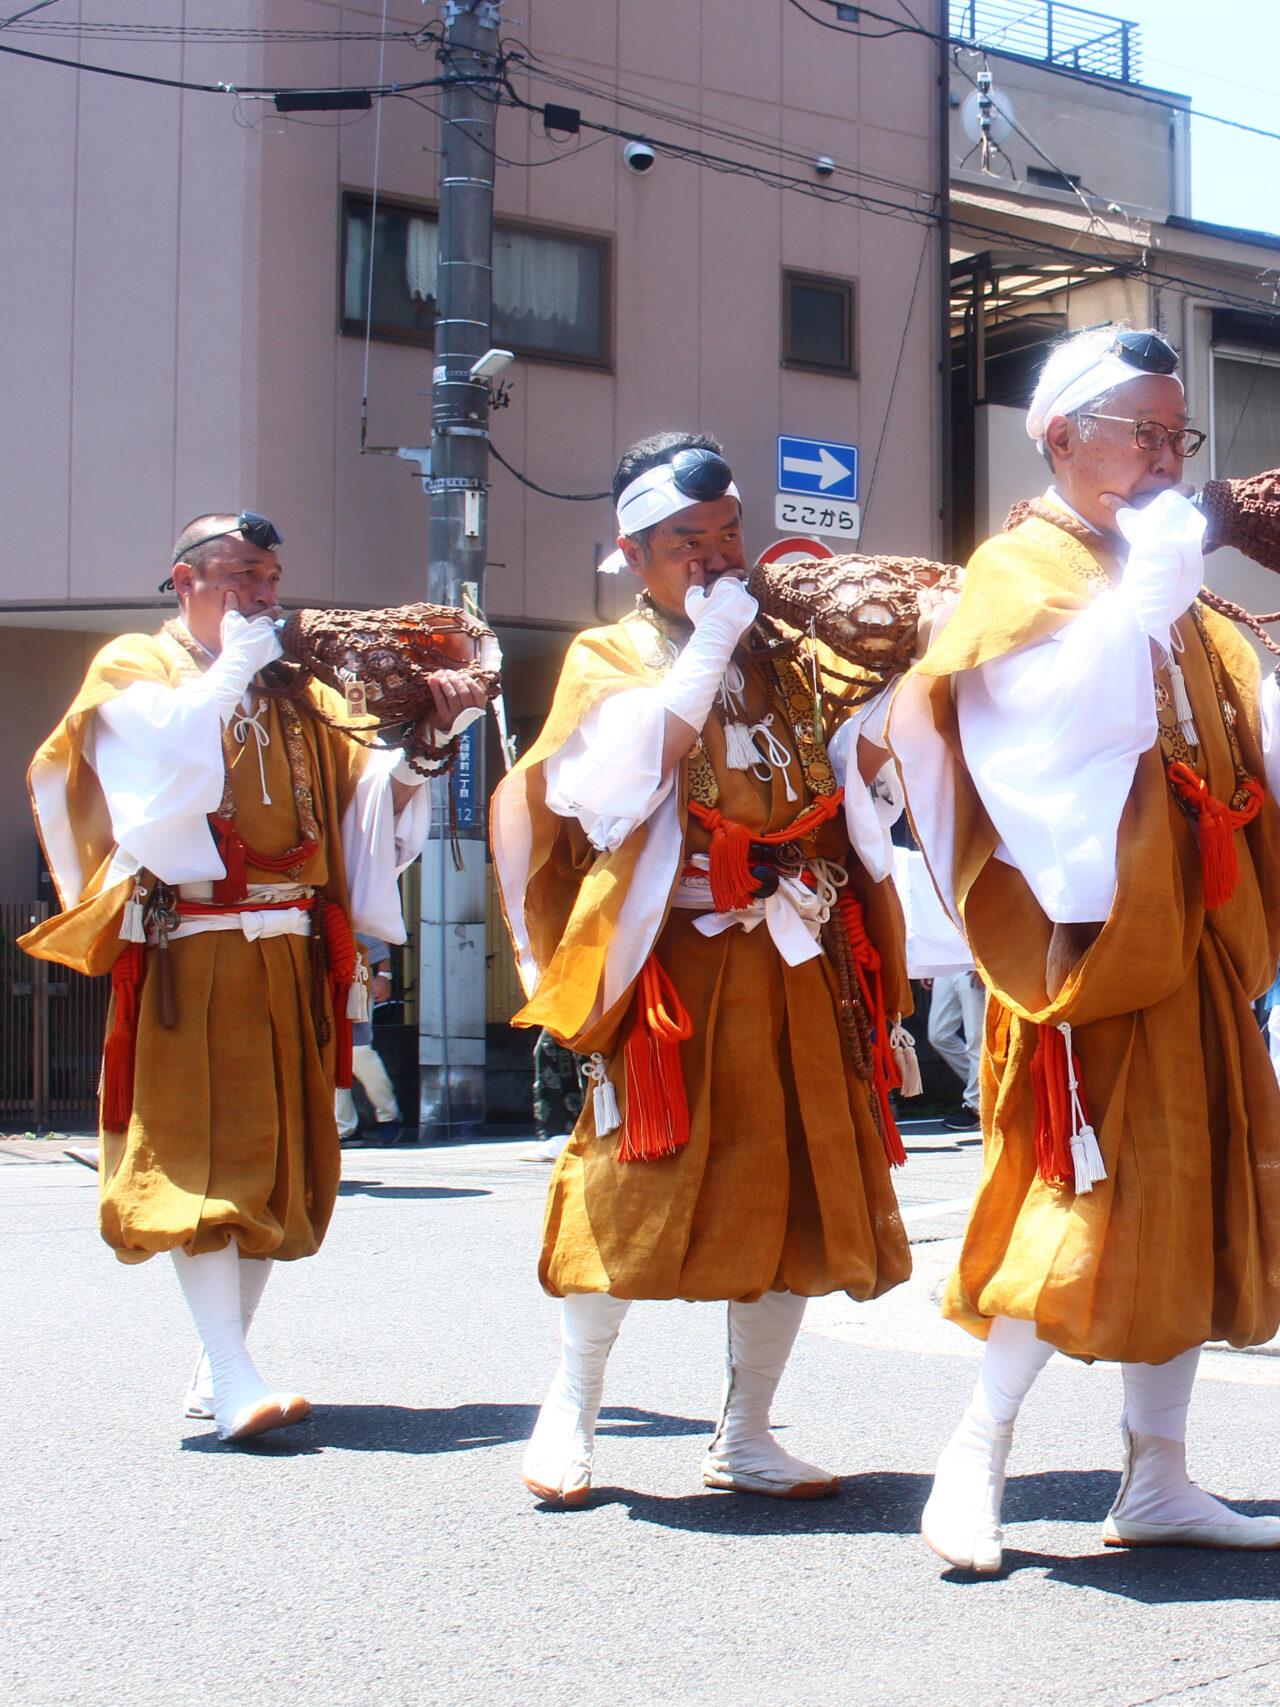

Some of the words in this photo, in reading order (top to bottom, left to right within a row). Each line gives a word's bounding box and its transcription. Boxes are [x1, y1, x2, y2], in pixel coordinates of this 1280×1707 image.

[782, 504, 854, 530] ここから
[459, 734, 471, 798] 大師駅前一丁目
